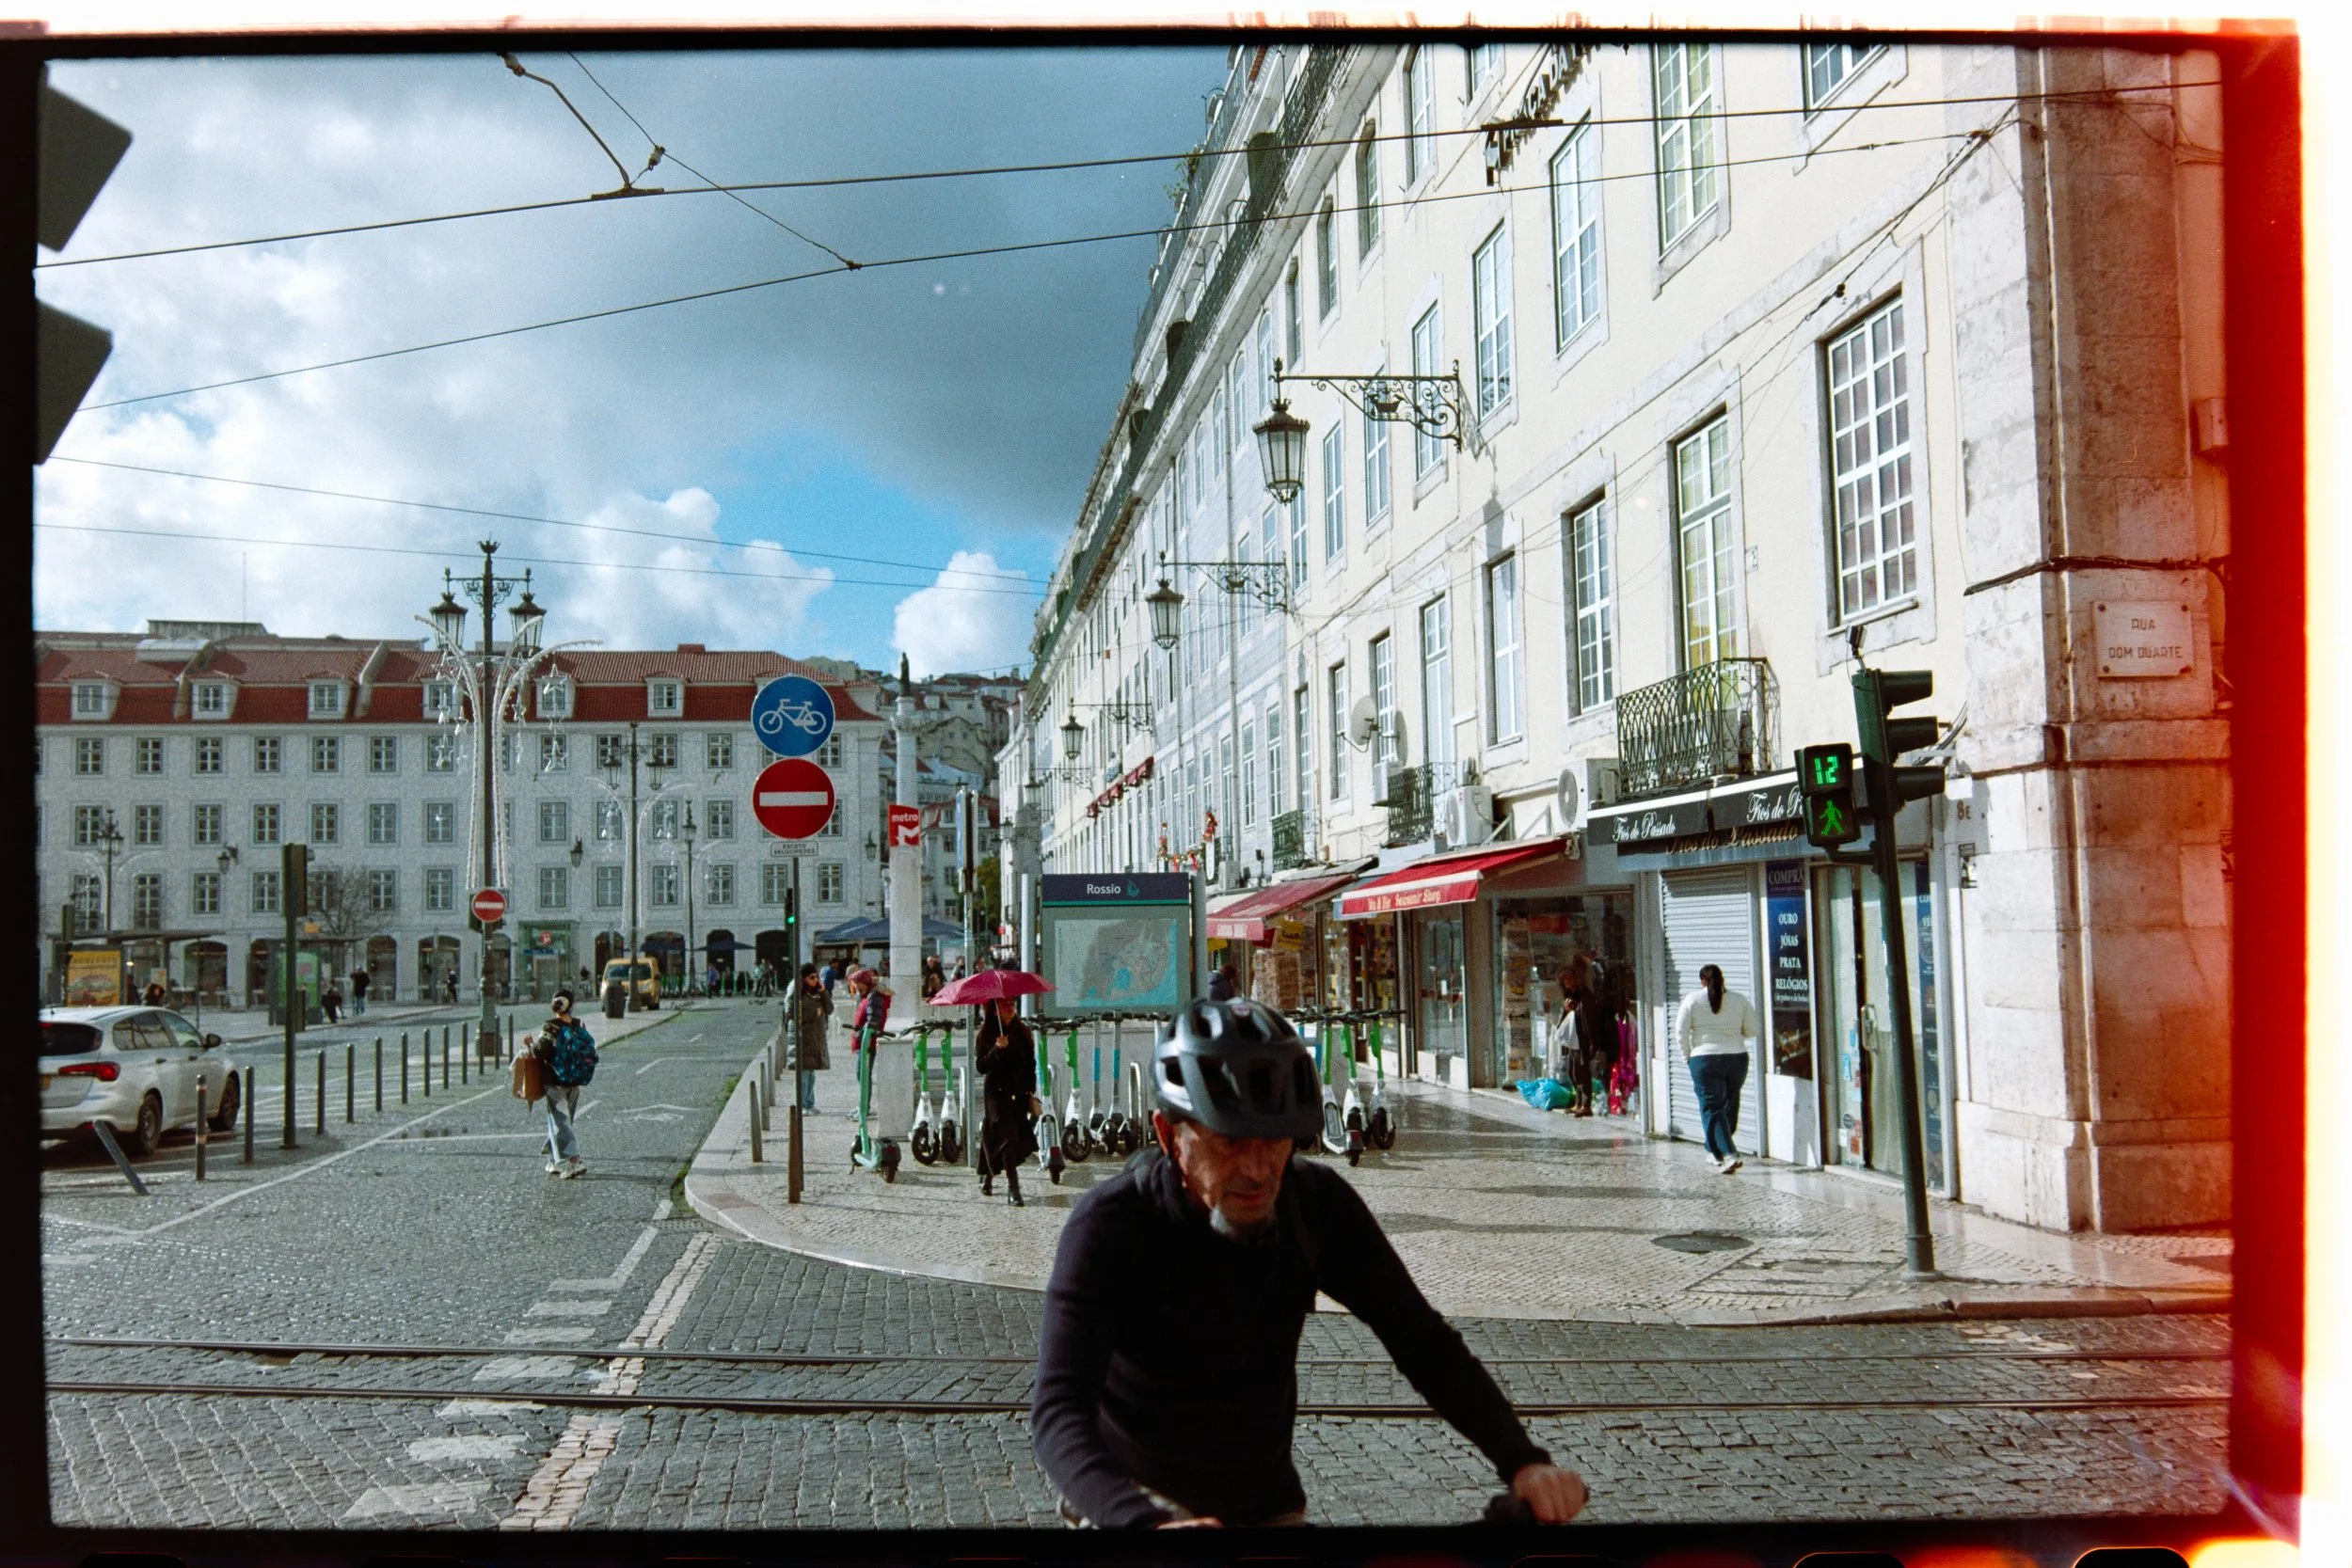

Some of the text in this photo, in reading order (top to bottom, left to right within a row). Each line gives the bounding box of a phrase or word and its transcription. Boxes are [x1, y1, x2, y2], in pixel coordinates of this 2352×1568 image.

[2131, 618, 2155, 630] RUA
[2108, 645, 2183, 659] DOM DUARTE
[1814, 755, 1839, 784] 12
[892, 813, 918, 823] metro
[1641, 811, 1676, 839] Passado
[1087, 883, 1121, 895] Rossio
[1778, 912, 1798, 925] OURO
[1780, 933, 1799, 949] JÓIAS
[1779, 957, 1801, 969] PRATA
[1775, 976, 1808, 991] RELÓGIOS
